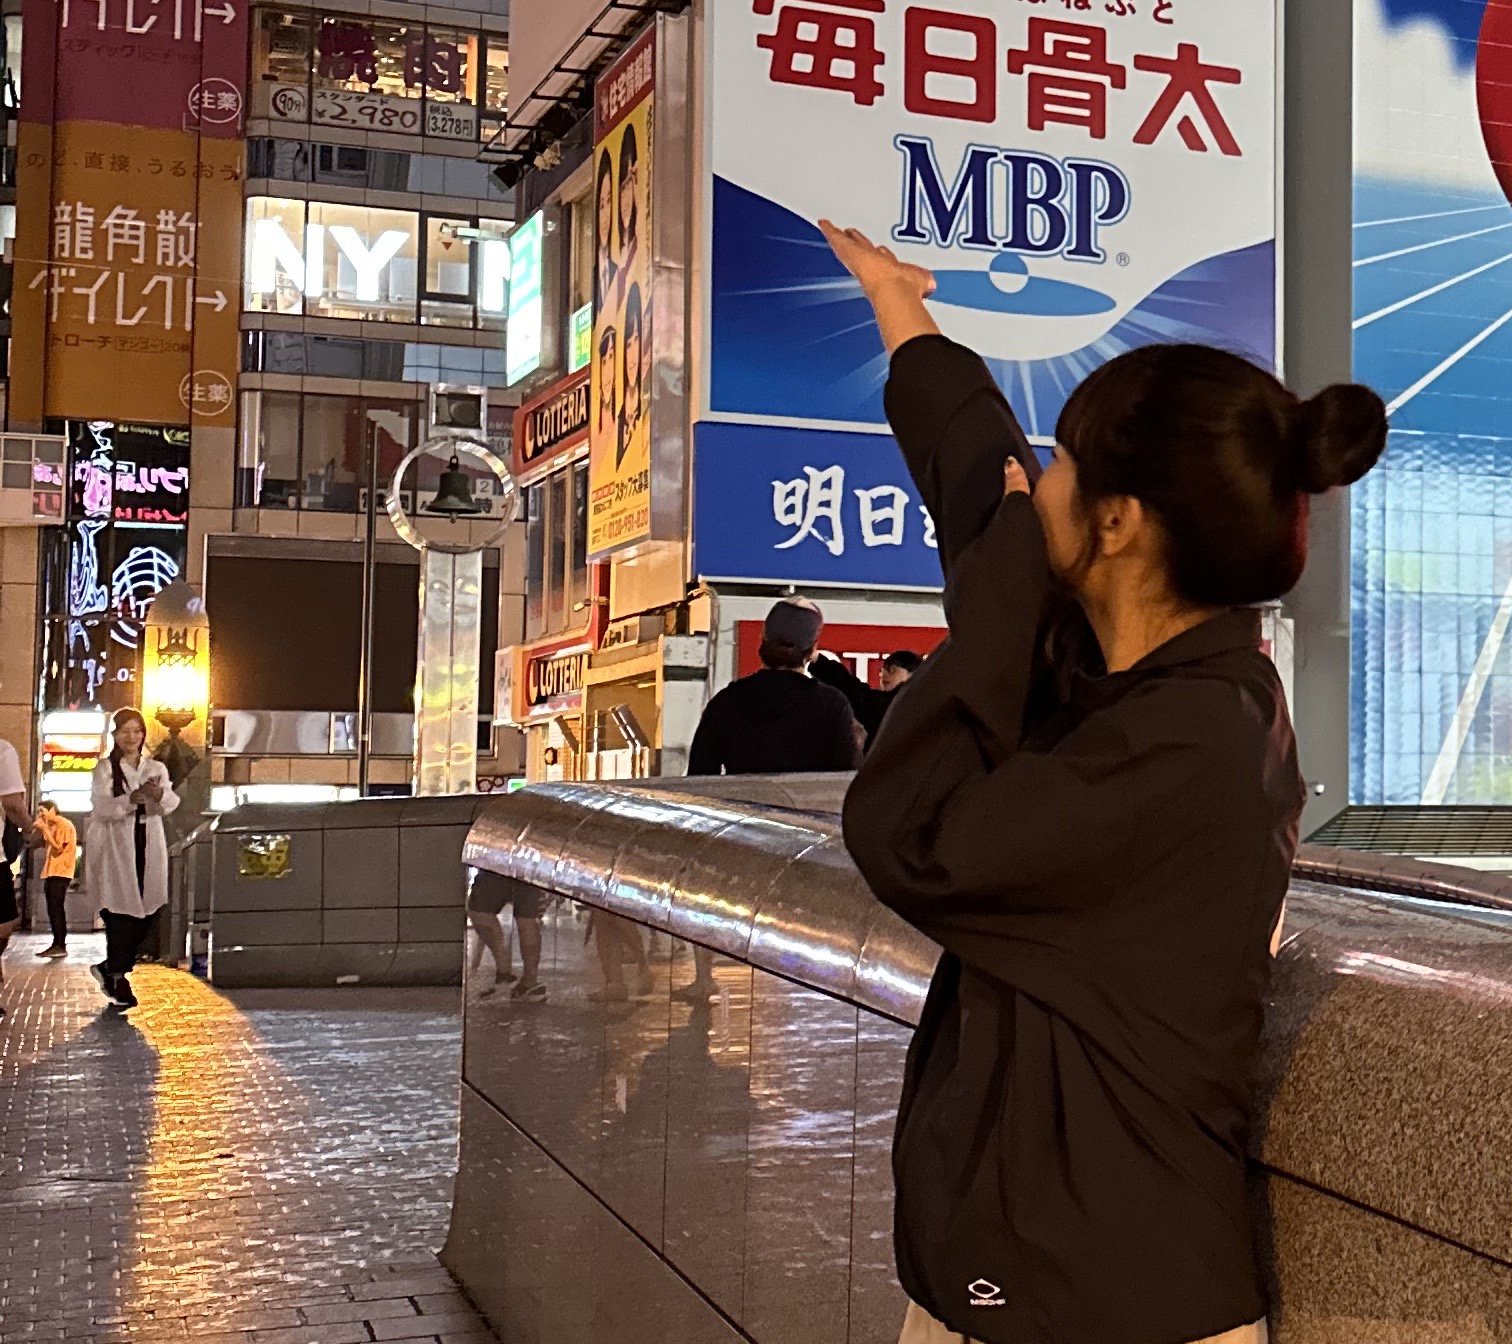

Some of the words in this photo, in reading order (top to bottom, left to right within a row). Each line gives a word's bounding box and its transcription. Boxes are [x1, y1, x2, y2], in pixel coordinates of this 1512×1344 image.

[192, 87, 238, 112] 生薬
[893, 136, 1130, 264] MBP
[54, 200, 203, 268] 龍角散
[28, 267, 212, 332] ダイレクト
[184, 382, 229, 403] 生薬
[536, 386, 587, 448] LOTTERIA
